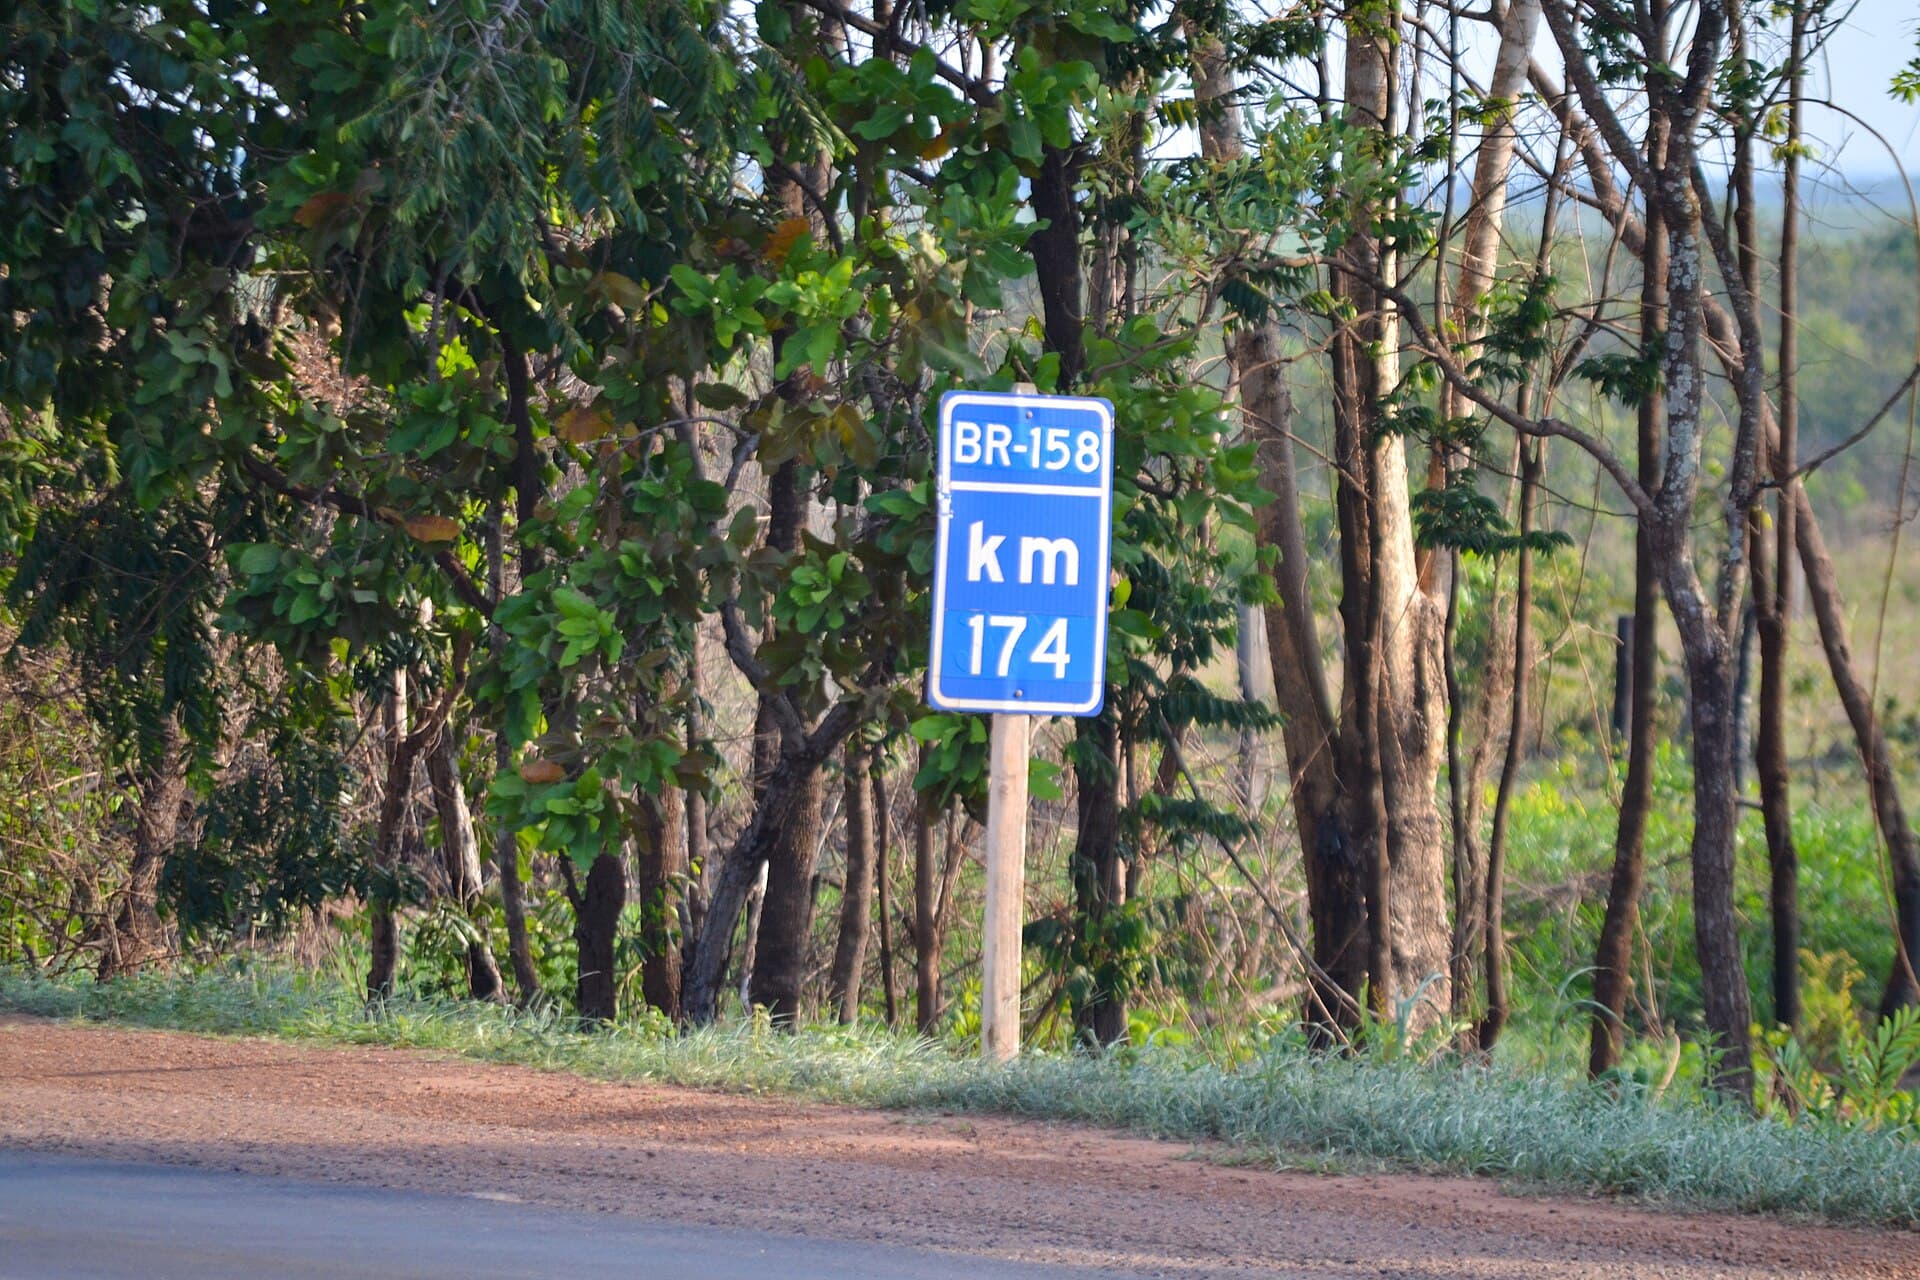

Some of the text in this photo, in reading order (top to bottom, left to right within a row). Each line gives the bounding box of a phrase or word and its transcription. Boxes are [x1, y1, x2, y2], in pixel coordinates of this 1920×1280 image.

[954, 421, 1100, 473] BR-158
[967, 520, 1079, 586] km
[968, 614, 1071, 679] 174
